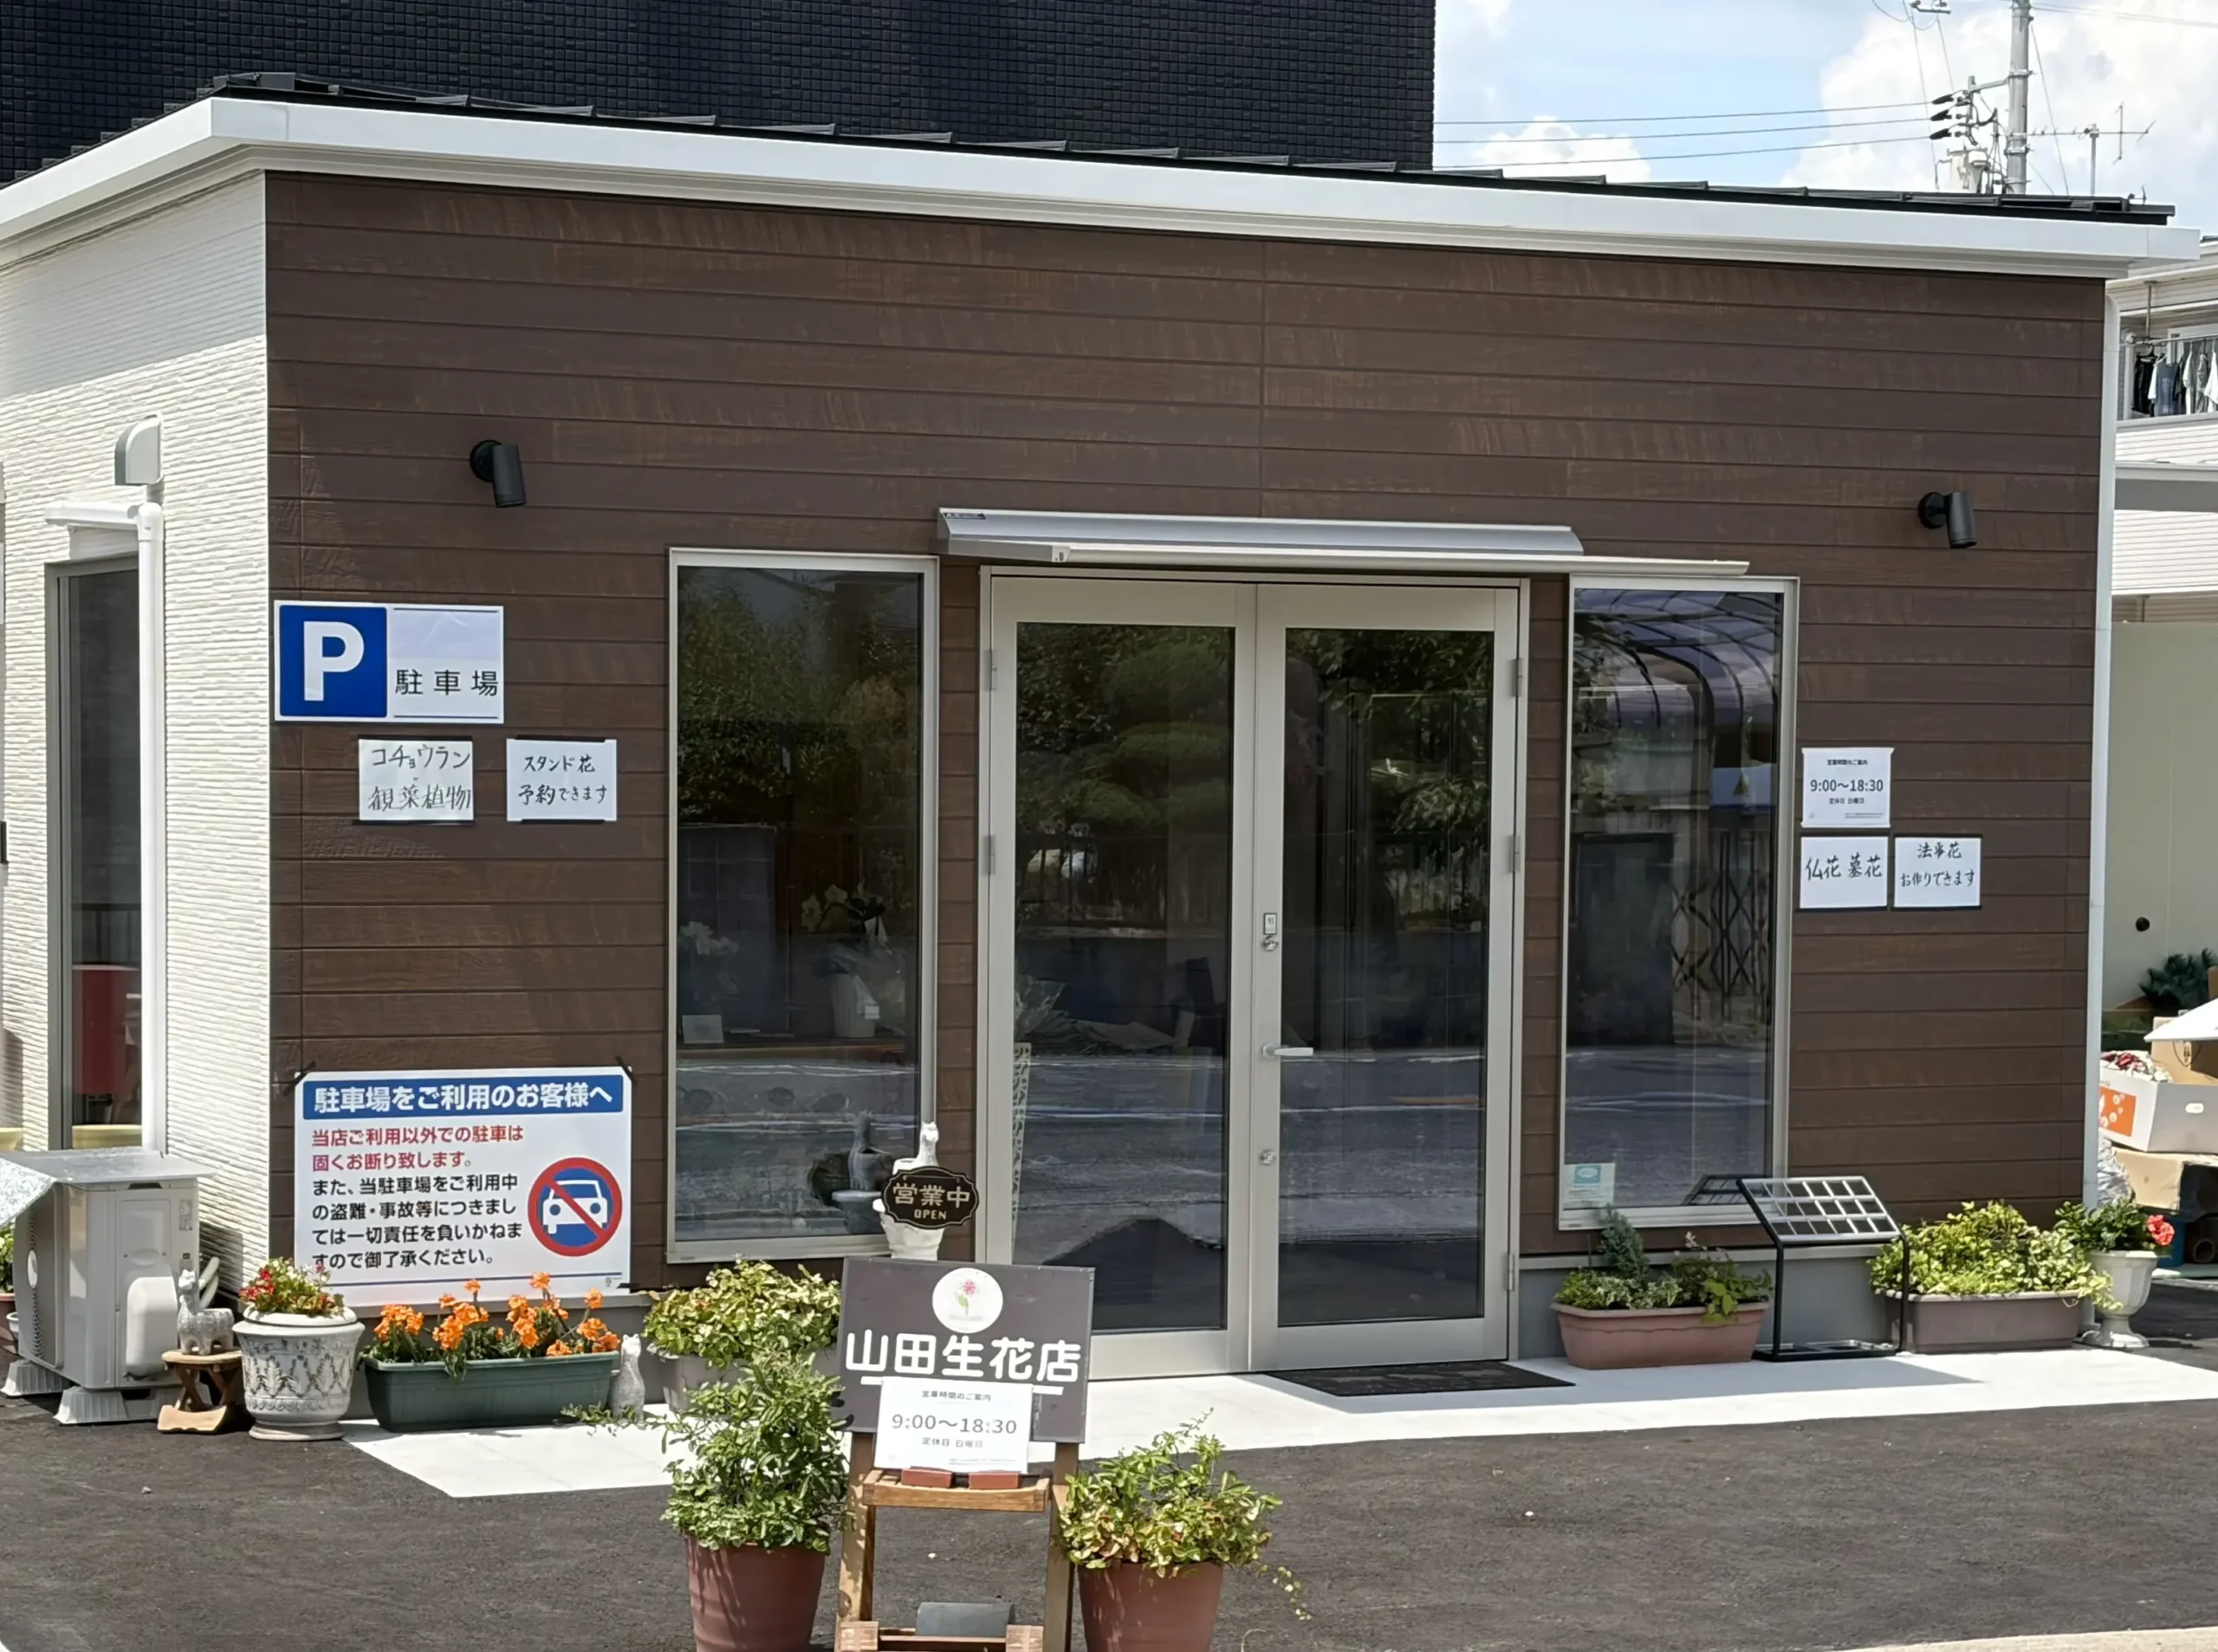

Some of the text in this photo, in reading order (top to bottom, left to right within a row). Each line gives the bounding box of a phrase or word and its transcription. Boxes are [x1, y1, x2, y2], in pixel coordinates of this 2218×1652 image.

[303, 620, 365, 702] P
[394, 669, 500, 696] 駐車場
[371, 744, 470, 769] コチョウラン
[523, 754, 596, 774] スタンド花
[367, 783, 471, 812] 観葉植物
[518, 785, 608, 806] 予約できます
[1805, 852, 1883, 881] 仏花 墓花
[1900, 868, 1975, 887] お作りできます
[314, 1081, 613, 1113] 駐車場をご利用のお客様へ
[311, 1124, 524, 1148] 当店ご利用以外での駐車は
[312, 1150, 471, 1172] 固くお断り致します。
[312, 1174, 519, 1196] また、当駐車場をご利用中
[892, 1182, 970, 1208] 営業中
[312, 1198, 517, 1221] の盗難・事故等につきまし
[914, 1208, 947, 1221] OPEN
[311, 1221, 522, 1245] ては一切責任を負いかねま
[311, 1248, 494, 1271] すので御了承ください。
[846, 1329, 1081, 1383] 山田生花店
